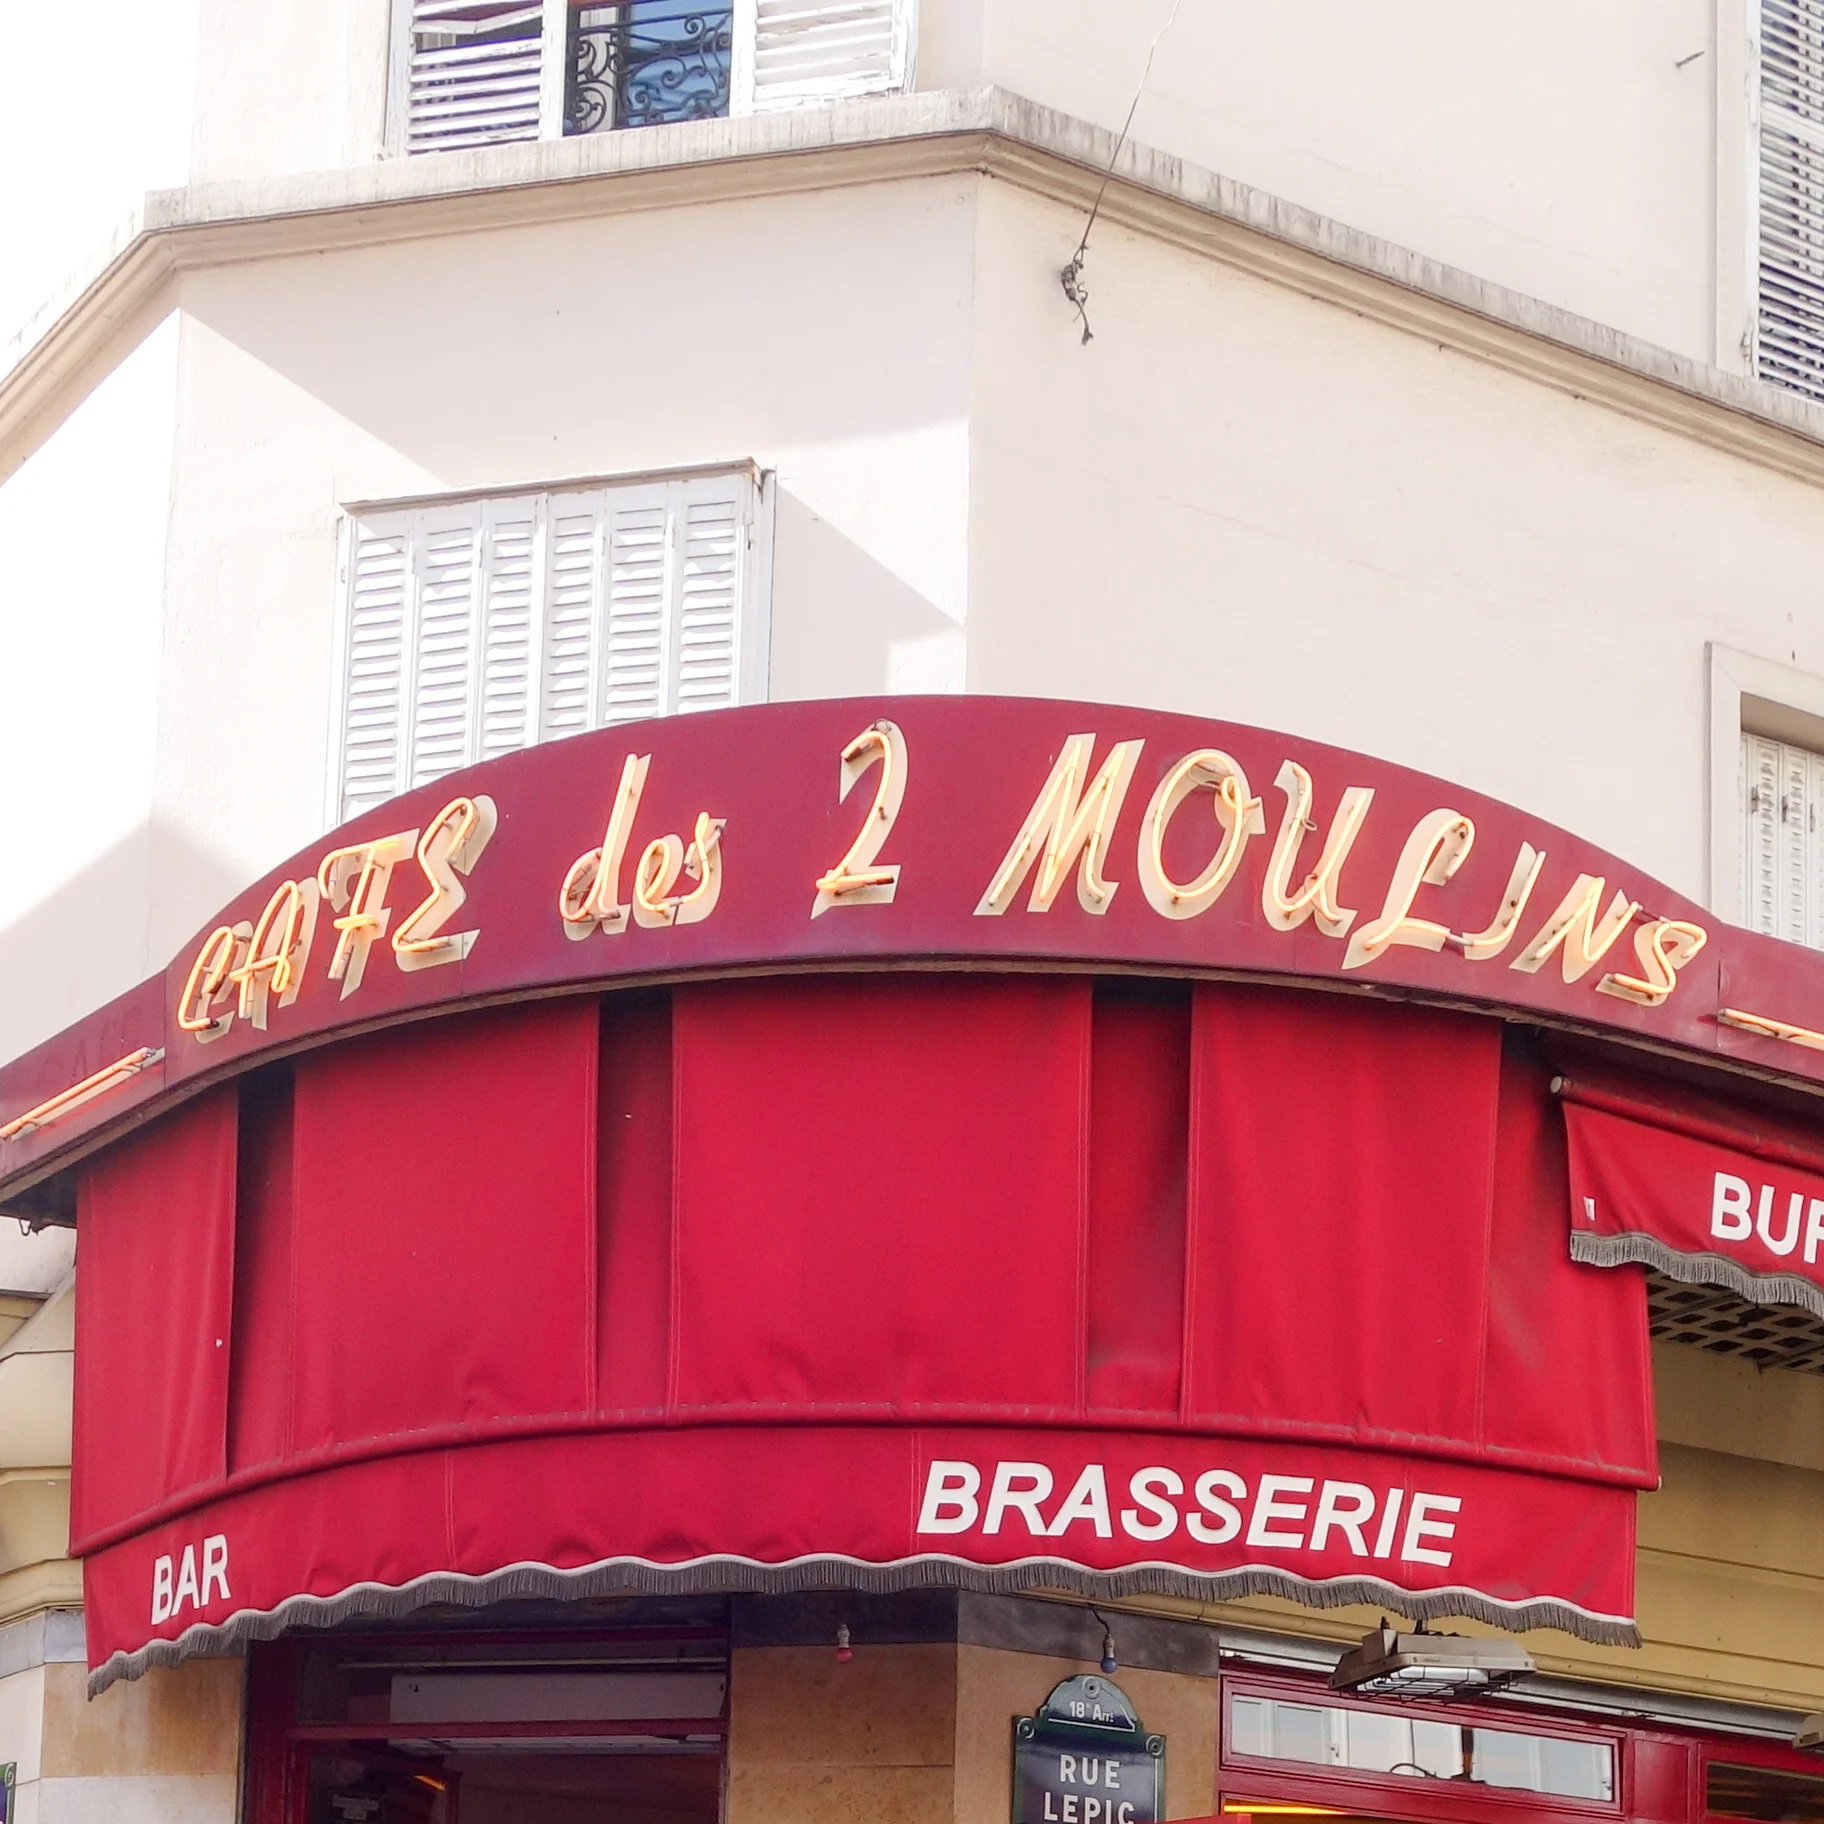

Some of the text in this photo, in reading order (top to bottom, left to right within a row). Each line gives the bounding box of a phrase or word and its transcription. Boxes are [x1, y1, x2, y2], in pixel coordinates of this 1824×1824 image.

[177, 719, 1710, 1045] CAFE des 2 MOULINS
[916, 1459, 1462, 1568] BRASSERIE
[151, 1532, 232, 1626] BAR
[1060, 1754, 1120, 1789] RUE
